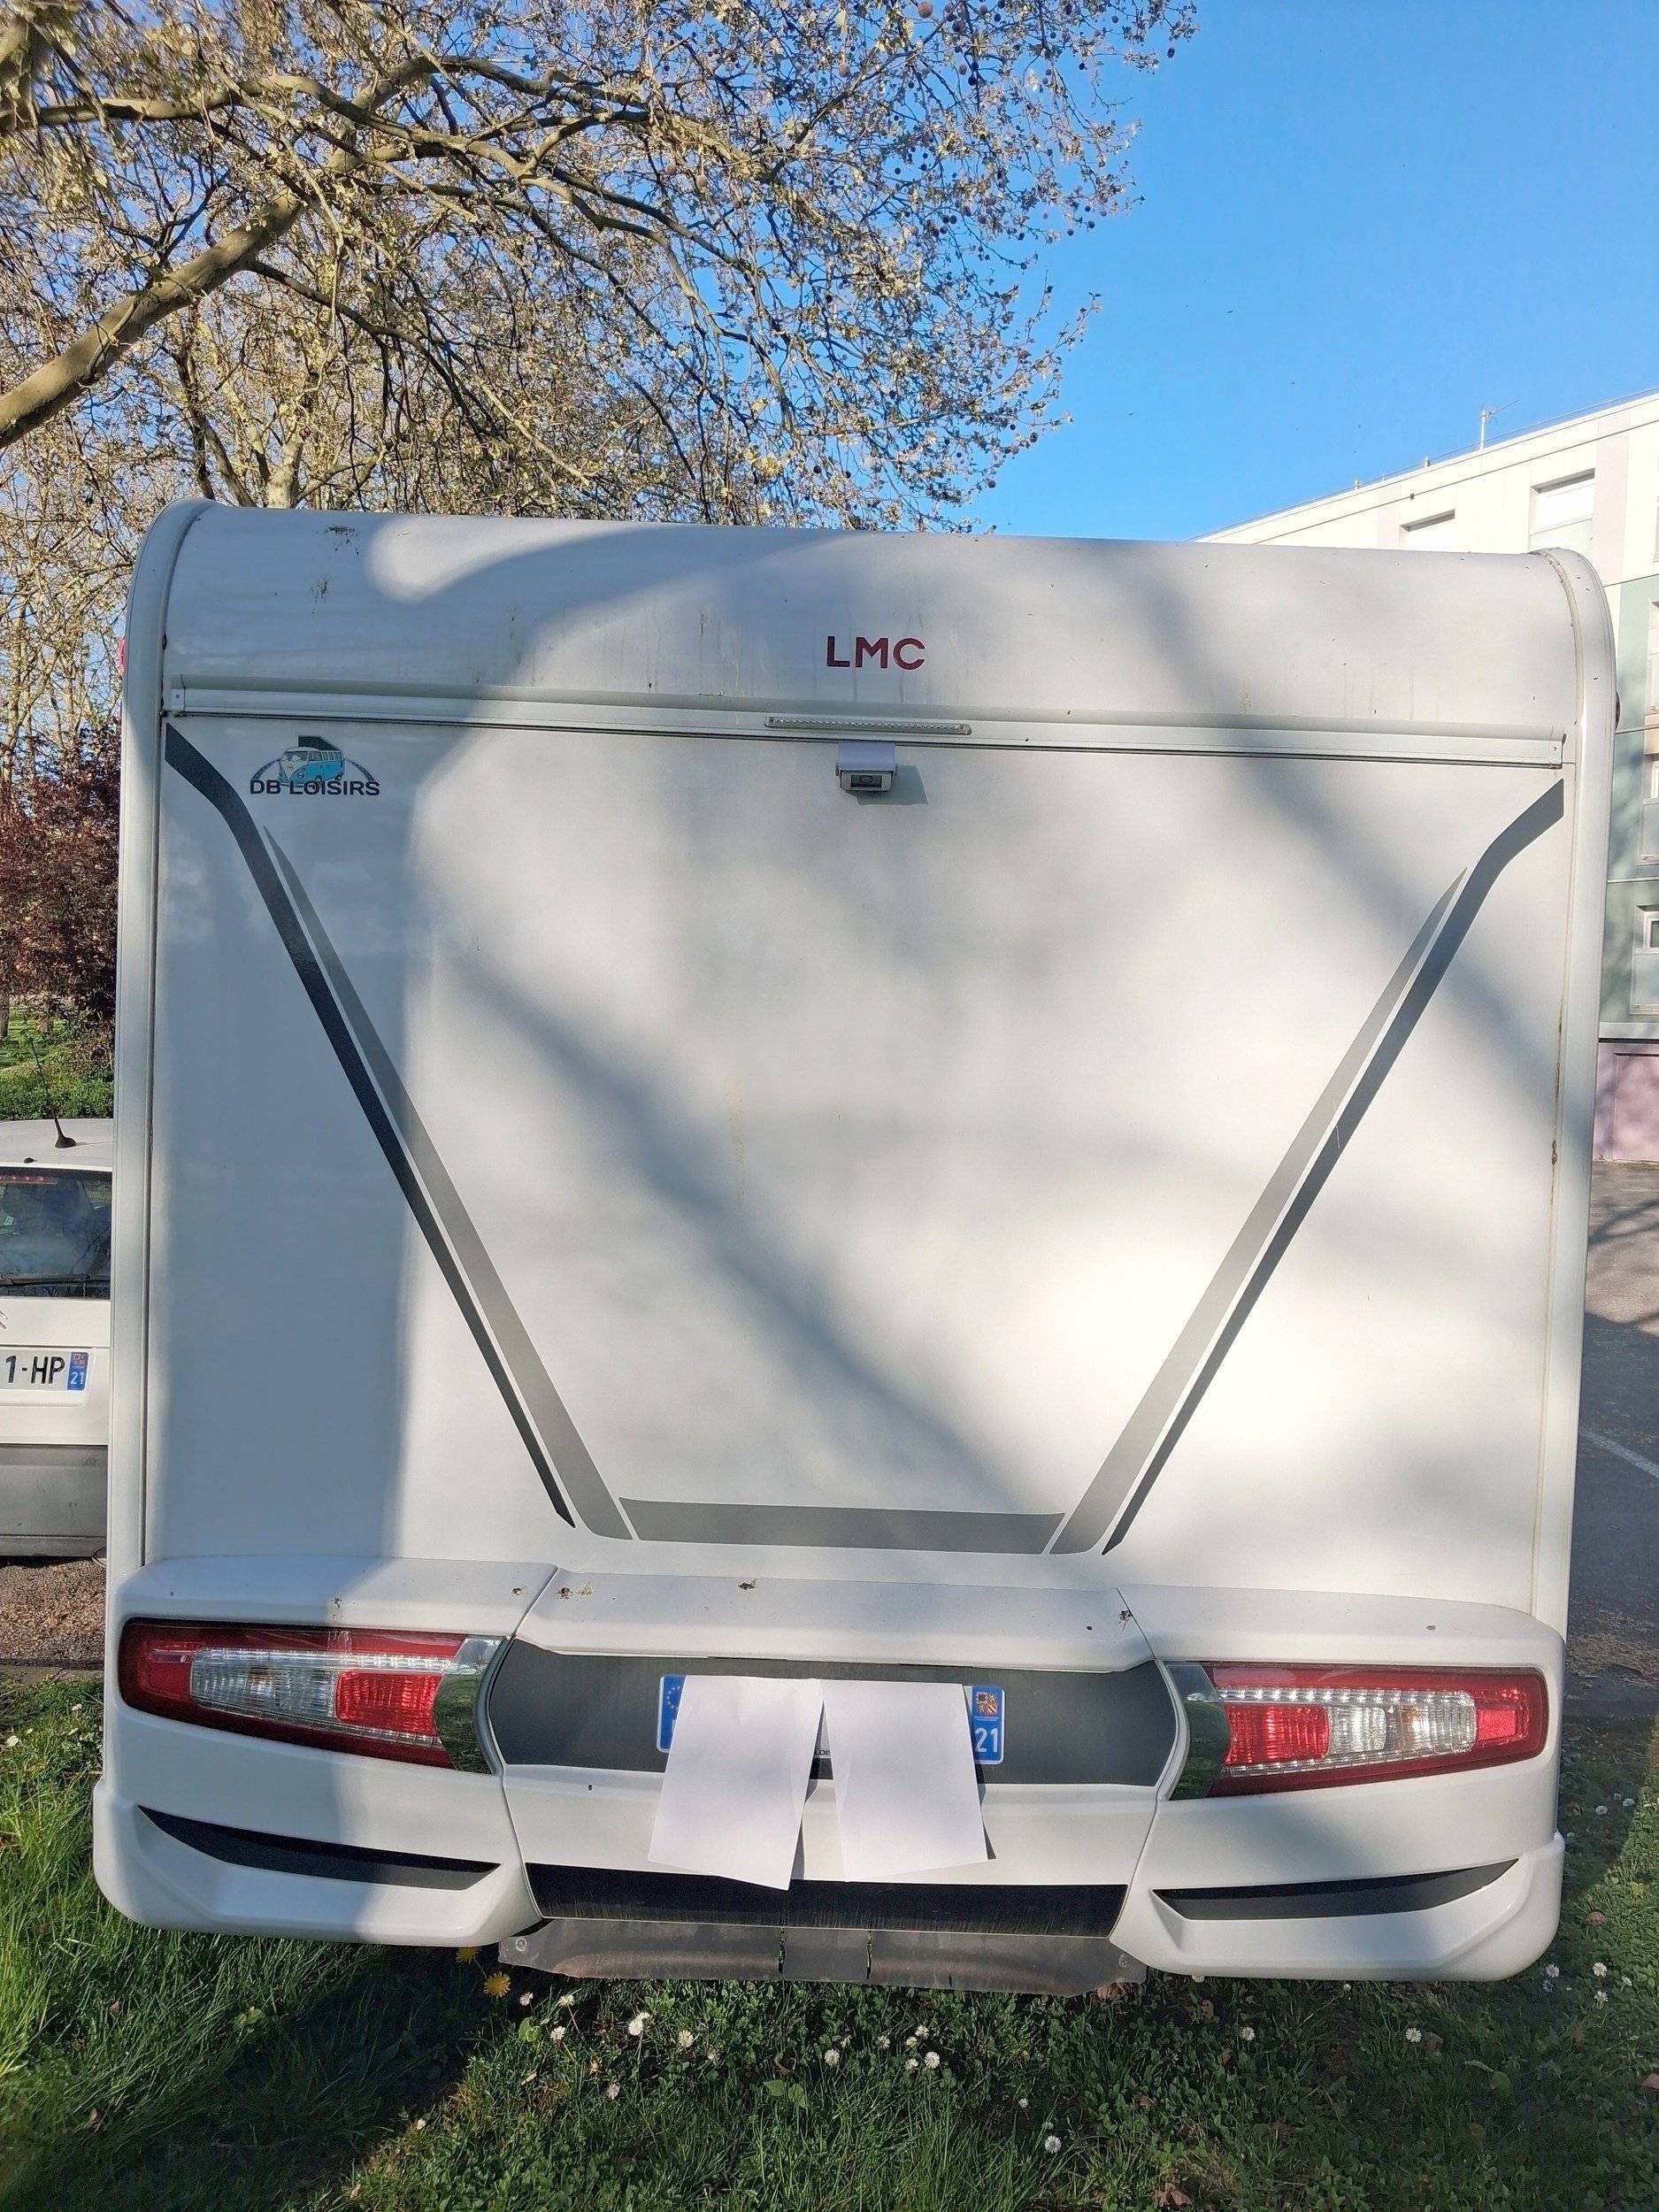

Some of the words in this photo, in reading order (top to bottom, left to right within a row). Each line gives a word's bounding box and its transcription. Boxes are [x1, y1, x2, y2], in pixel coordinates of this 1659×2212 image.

[826, 635, 926, 671] LMC
[250, 780, 281, 795] DB
[289, 780, 380, 796] LOISIRS
[70, 1371, 84, 1385] 21
[974, 1727, 999, 1753] 21
